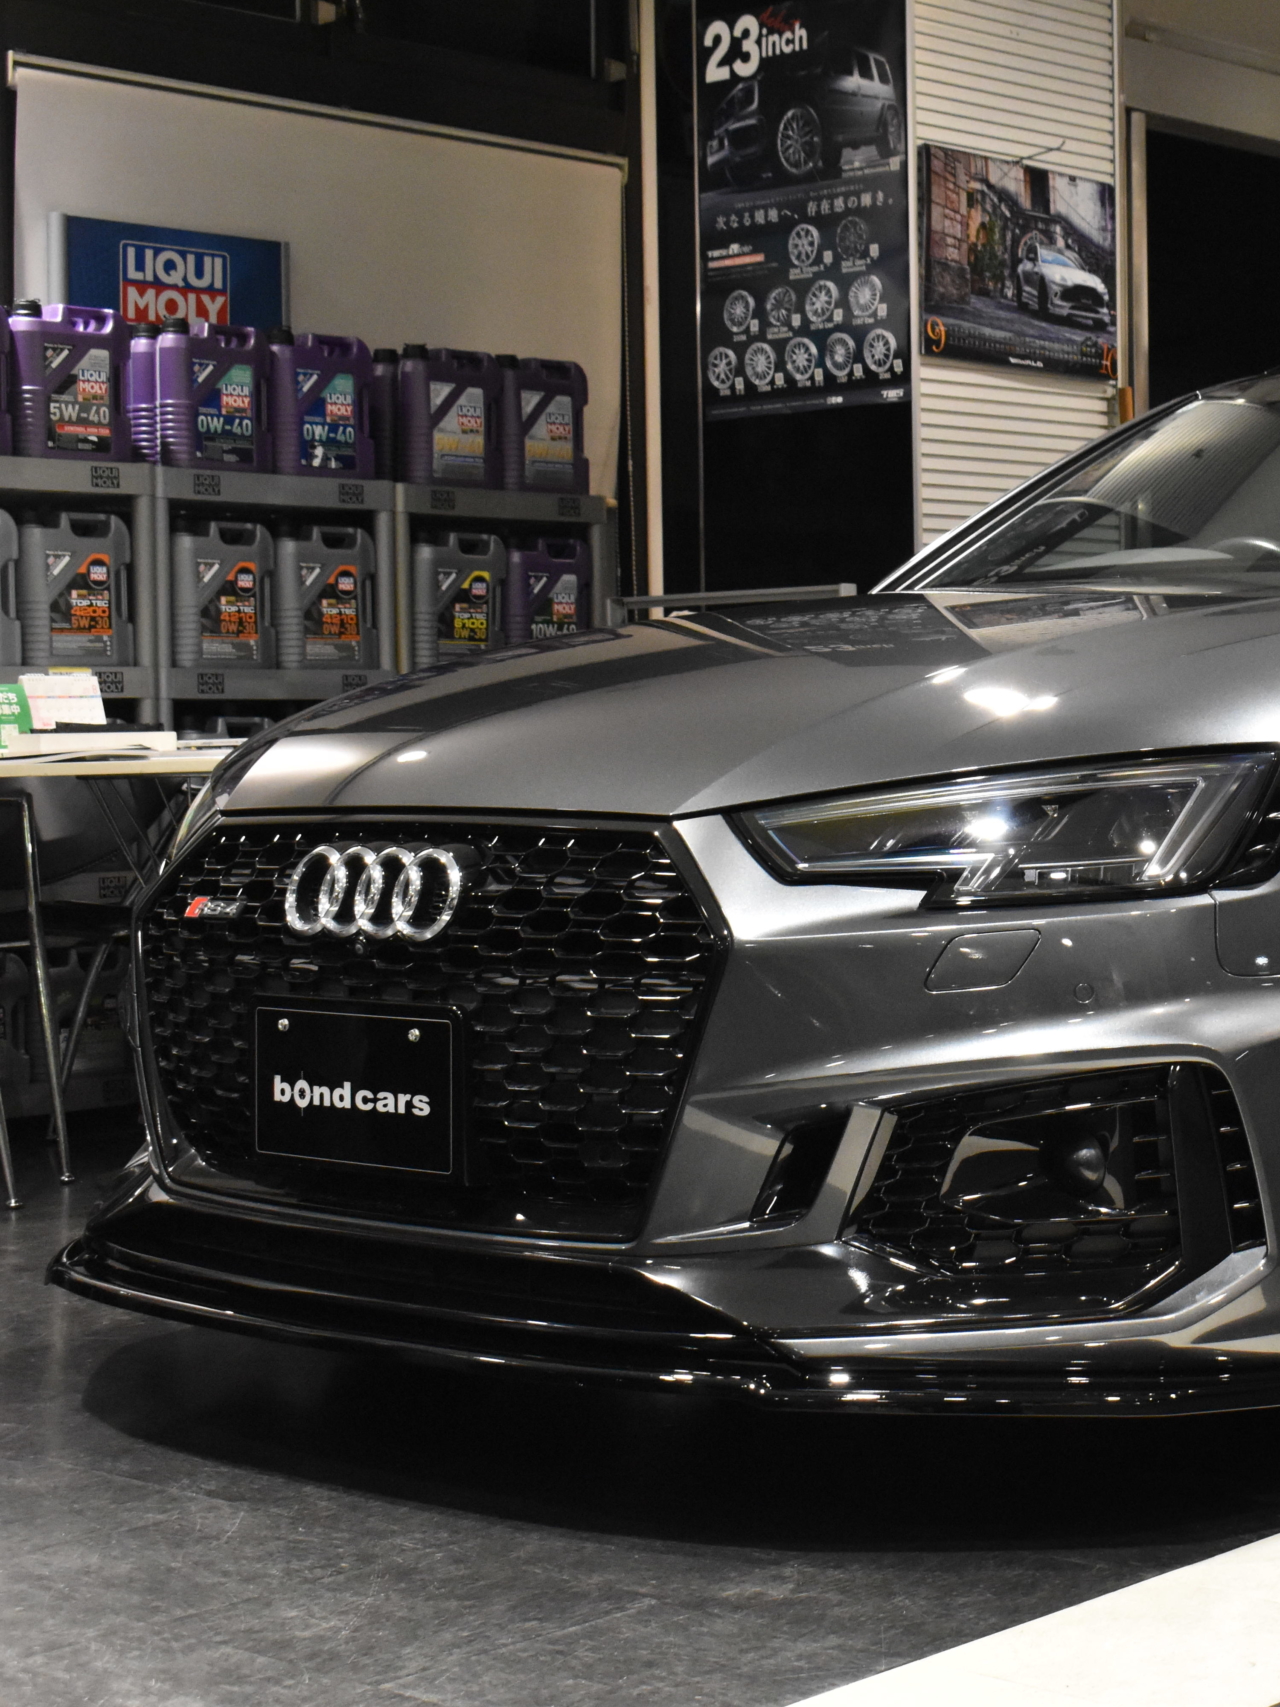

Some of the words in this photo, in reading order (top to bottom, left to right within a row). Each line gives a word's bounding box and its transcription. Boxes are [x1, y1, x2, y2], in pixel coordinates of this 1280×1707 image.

[126, 246, 223, 290] LIQUI
[127, 286, 227, 325] MOLY
[927, 316, 946, 353] 9
[79, 369, 107, 382] LIQUI
[79, 382, 107, 394] MOLY
[222, 384, 249, 396] LIQUI
[222, 395, 250, 407] MOLY
[327, 393, 352, 404] LIQUI
[49, 403, 110, 425] 5W-40
[327, 404, 353, 415] MOLY
[458, 405, 482, 417] LIQUI
[458, 415, 482, 427] MOLY
[547, 413, 570, 424] LIQUI
[197, 415, 252, 436] 0W-40
[547, 423, 571, 434] MOLY
[303, 423, 354, 443] 0W-40
[93, 466, 118, 478] LIQUI
[93, 477, 119, 488] MOLY
[194, 474, 220, 485] LIQUI
[195, 485, 221, 496] MOLY
[71, 599, 91, 607] TOP
[91, 599, 109, 607] TEC
[554, 593, 575, 603] LIQUI
[70, 606, 109, 617] 4200
[238, 605, 255, 613] TEC
[322, 607, 339, 615] TOP
[554, 603, 576, 614] MOLY
[71, 616, 109, 629] 5W-30
[220, 612, 255, 622] 4210
[322, 614, 356, 624] 4210
[220, 622, 256, 634] 0W-30
[454, 618, 487, 628] 6100
[322, 623, 357, 635] 0W-30
[454, 628, 486, 639] 0W-30
[198, 673, 223, 684] LIQUI
[343, 675, 367, 685] LIQUI
[198, 684, 223, 694] MOLY
[273, 1075, 431, 1117] bondcars
